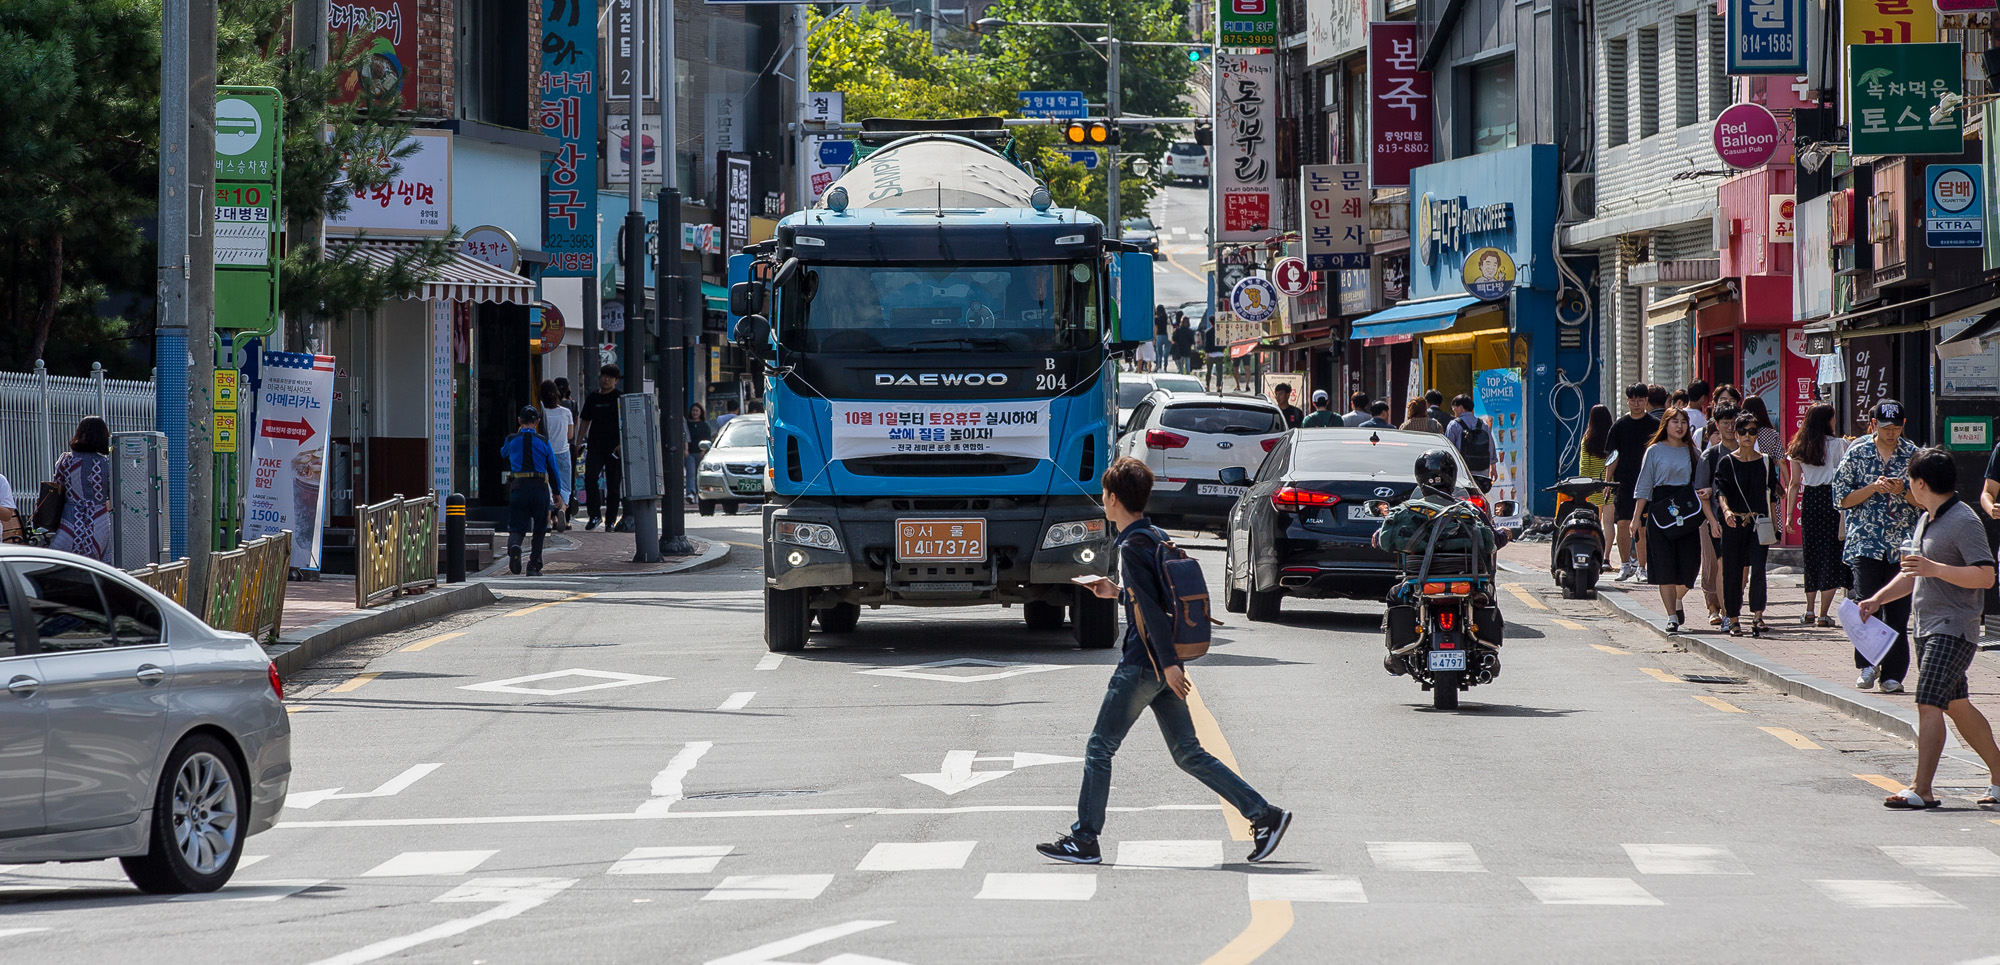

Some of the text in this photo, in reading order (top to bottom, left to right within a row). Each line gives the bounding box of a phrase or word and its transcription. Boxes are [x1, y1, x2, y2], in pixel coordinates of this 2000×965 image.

[1256, 22, 1274, 32] 3F
[1223, 34, 1274, 44] 875-3999
[1742, 34, 1792, 53] 814-1585
[1379, 38, 1427, 121] 본죽
[1233, 80, 1267, 183] 돈부리
[1721, 122, 1747, 135] Red
[1385, 131, 1422, 141] 중앙대점
[1722, 134, 1773, 148] Balloon
[1378, 143, 1429, 153] 813-8802
[215, 160, 268, 175] 버스승차장
[1309, 171, 1363, 191] 논문
[1939, 181, 1970, 197] 담배
[233, 187, 261, 205] 10
[1310, 197, 1363, 219] 인쇄
[1482, 202, 1507, 231] COFFEE
[1936, 221, 1973, 229] KTRA
[1312, 225, 1366, 247] 복사
[468, 242, 508, 256] 왕돈까스
[1312, 254, 1366, 268] 동아사
[1476, 282, 1504, 293] 빽다방
[1045, 358, 1055, 370] B
[875, 373, 1008, 386] DAEWOO
[1036, 373, 1067, 390] 204
[1487, 377, 1500, 387] TOP
[1750, 369, 1778, 393] Salsa
[1481, 386, 1514, 399] SUMMER
[1856, 351, 1870, 422] 아메리카노
[265, 393, 321, 409] 아메리카노
[845, 410, 1038, 425] 10월 1일부터 토요휴무 실시하여
[888, 428, 993, 441] 삶에 질을 높이자!
[963, 443, 984, 451] 연합회
[258, 458, 281, 468] TAKE
[256, 468, 277, 478] OUT
[255, 477, 272, 489] 할인
[1222, 485, 1244, 496] 1696
[251, 509, 287, 523] 1500 원
[918, 525, 964, 537] 서울
[1440, 658, 1463, 667] 4797
